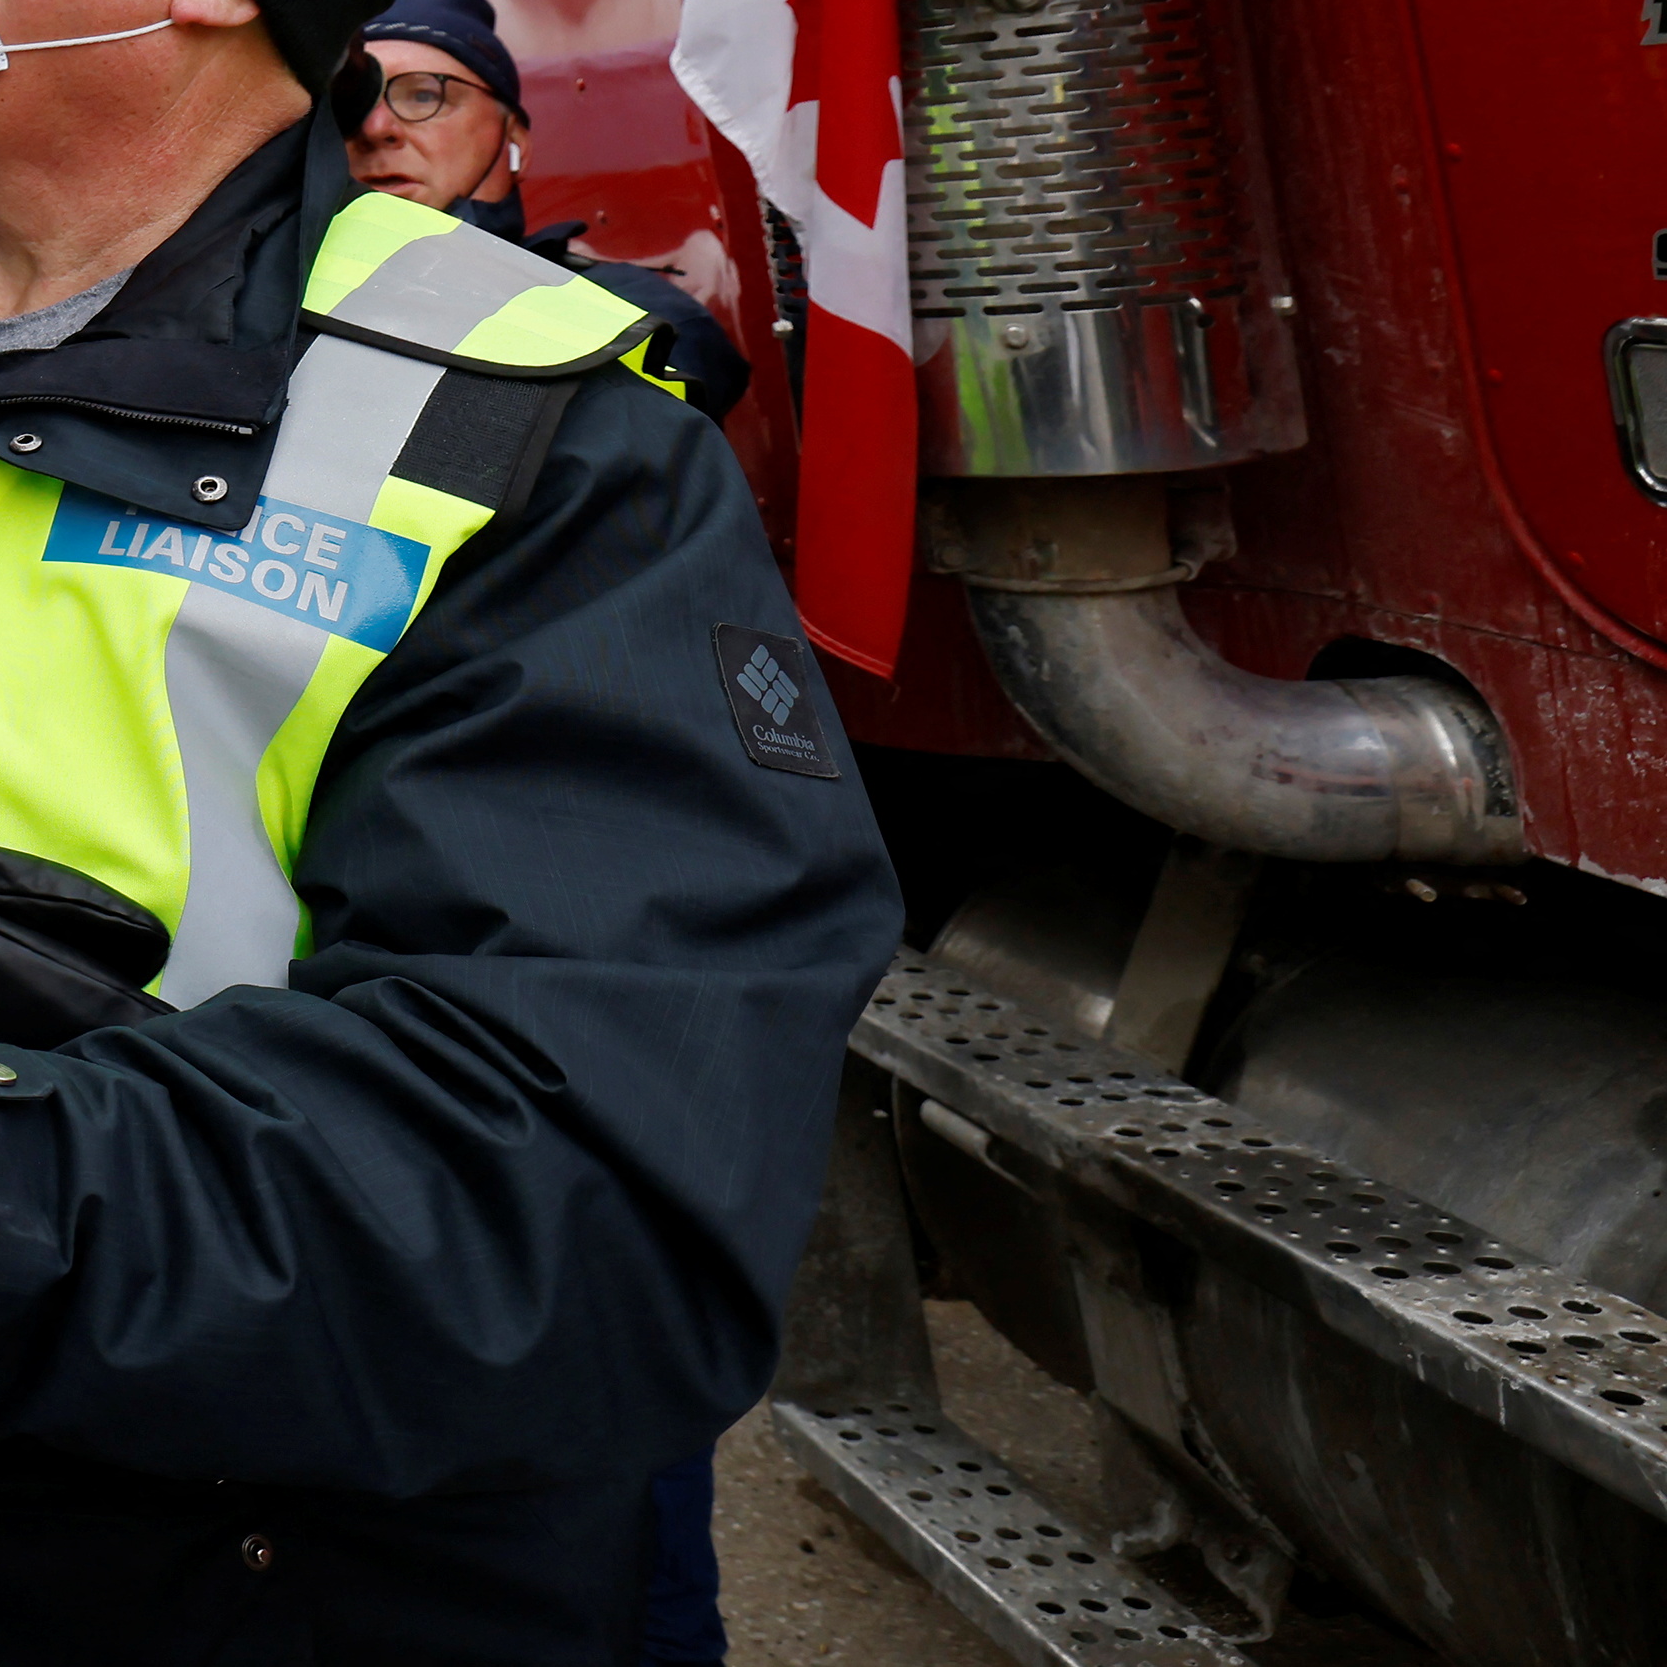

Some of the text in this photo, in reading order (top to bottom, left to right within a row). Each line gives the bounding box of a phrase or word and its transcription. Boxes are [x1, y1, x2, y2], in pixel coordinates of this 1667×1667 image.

[98, 520, 348, 622] LIAISON
[752, 724, 815, 751] Columbia
[757, 741, 820, 762] Sportswear Co.
